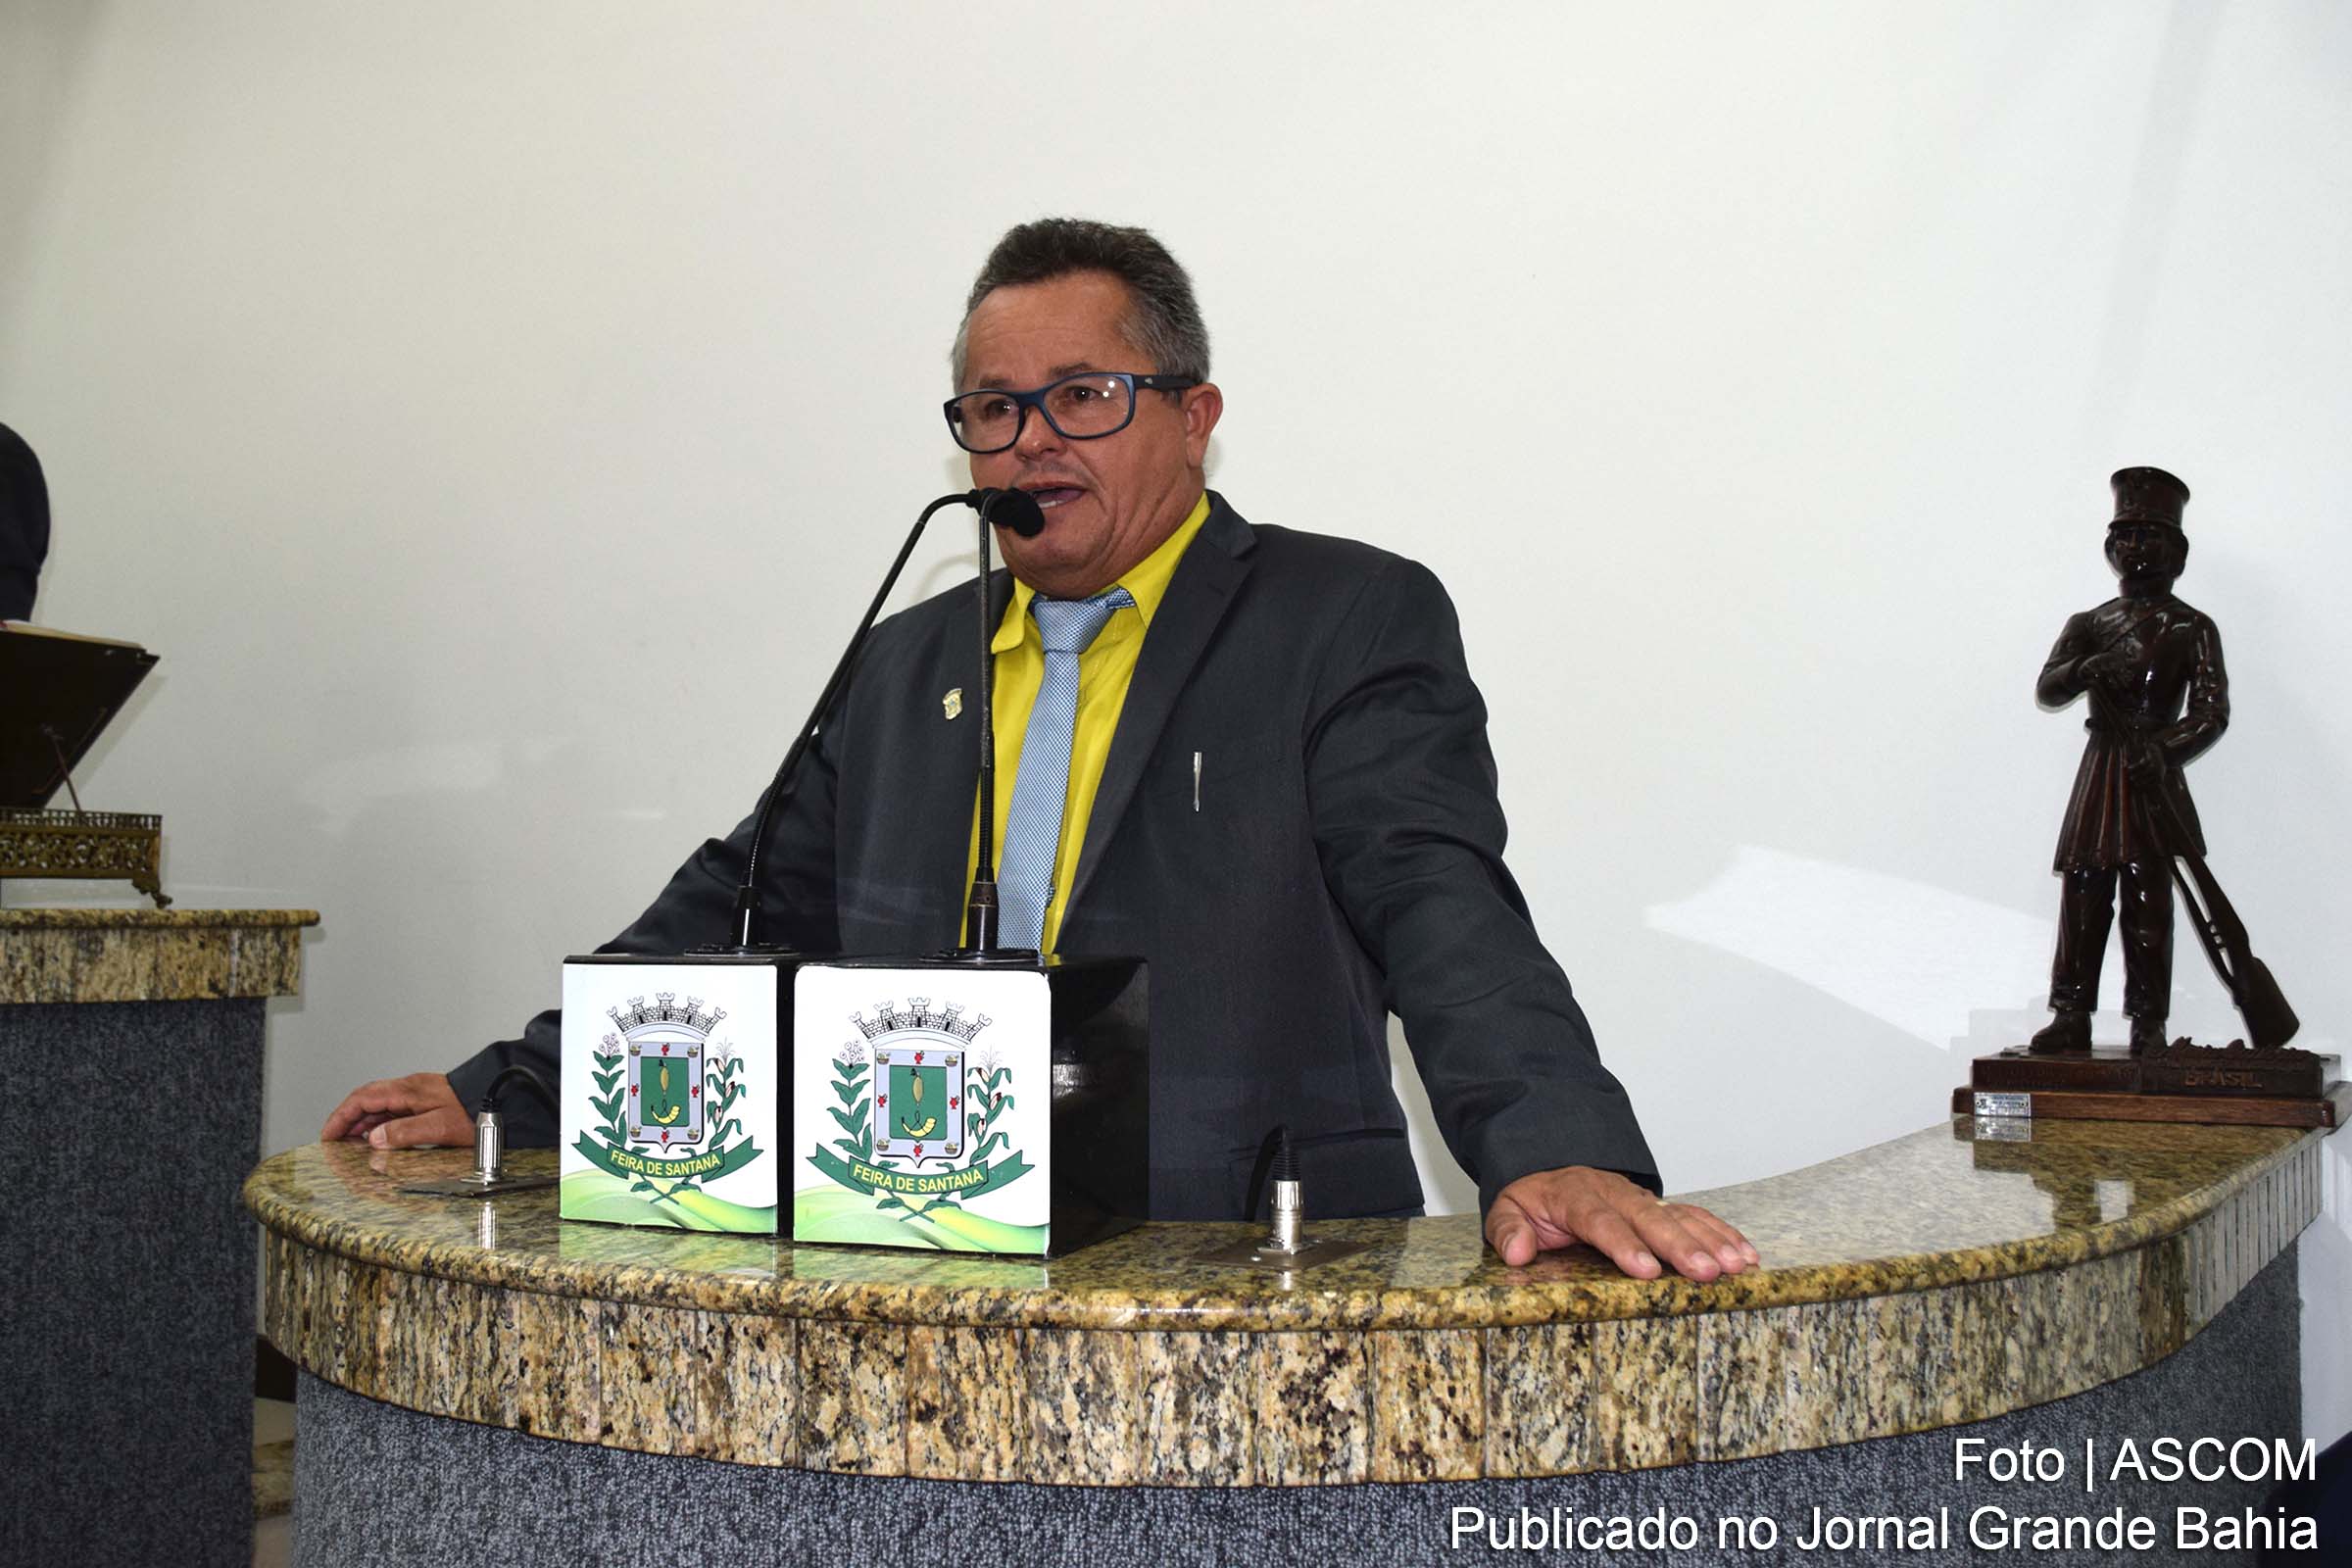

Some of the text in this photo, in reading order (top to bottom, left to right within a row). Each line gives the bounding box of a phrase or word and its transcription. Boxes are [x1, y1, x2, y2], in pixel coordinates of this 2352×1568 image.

[611, 1150, 720, 1176] FEIRA DE SANTANA
[853, 1164, 984, 1192] FEIRA DE SANTANA
